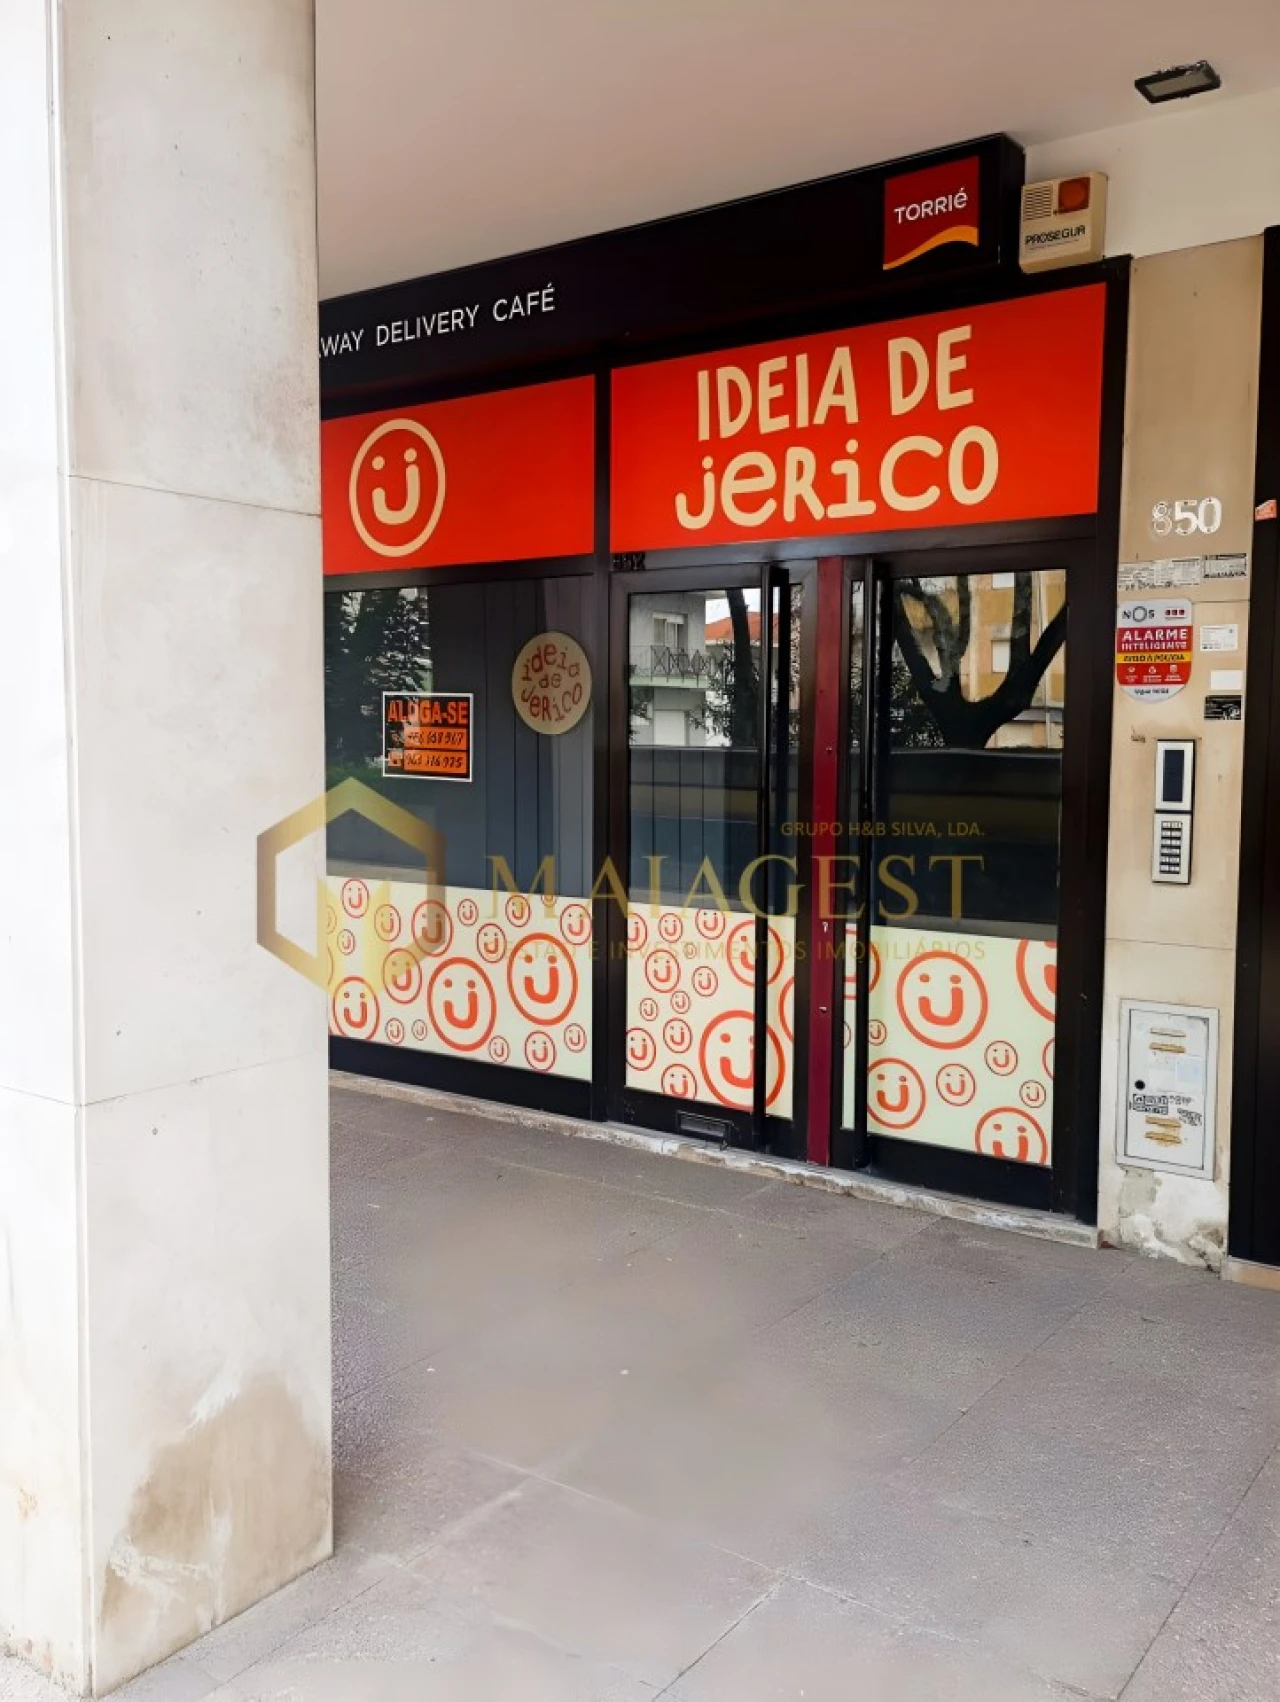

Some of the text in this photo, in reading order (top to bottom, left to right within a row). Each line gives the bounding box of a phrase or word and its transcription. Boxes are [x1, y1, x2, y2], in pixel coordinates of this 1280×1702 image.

[1024, 225, 1086, 247] PROSEGUR
[318, 282, 556, 359] WAY DELIVERY CAFÉ
[697, 324, 975, 442] IDEIA DE
[1152, 496, 1222, 537] 850
[1122, 605, 1156, 623] NOS
[1121, 628, 1189, 642] ALARME
[521, 643, 580, 682] ideia
[539, 672, 562, 689] de
[387, 699, 469, 725] ALUGA-SE
